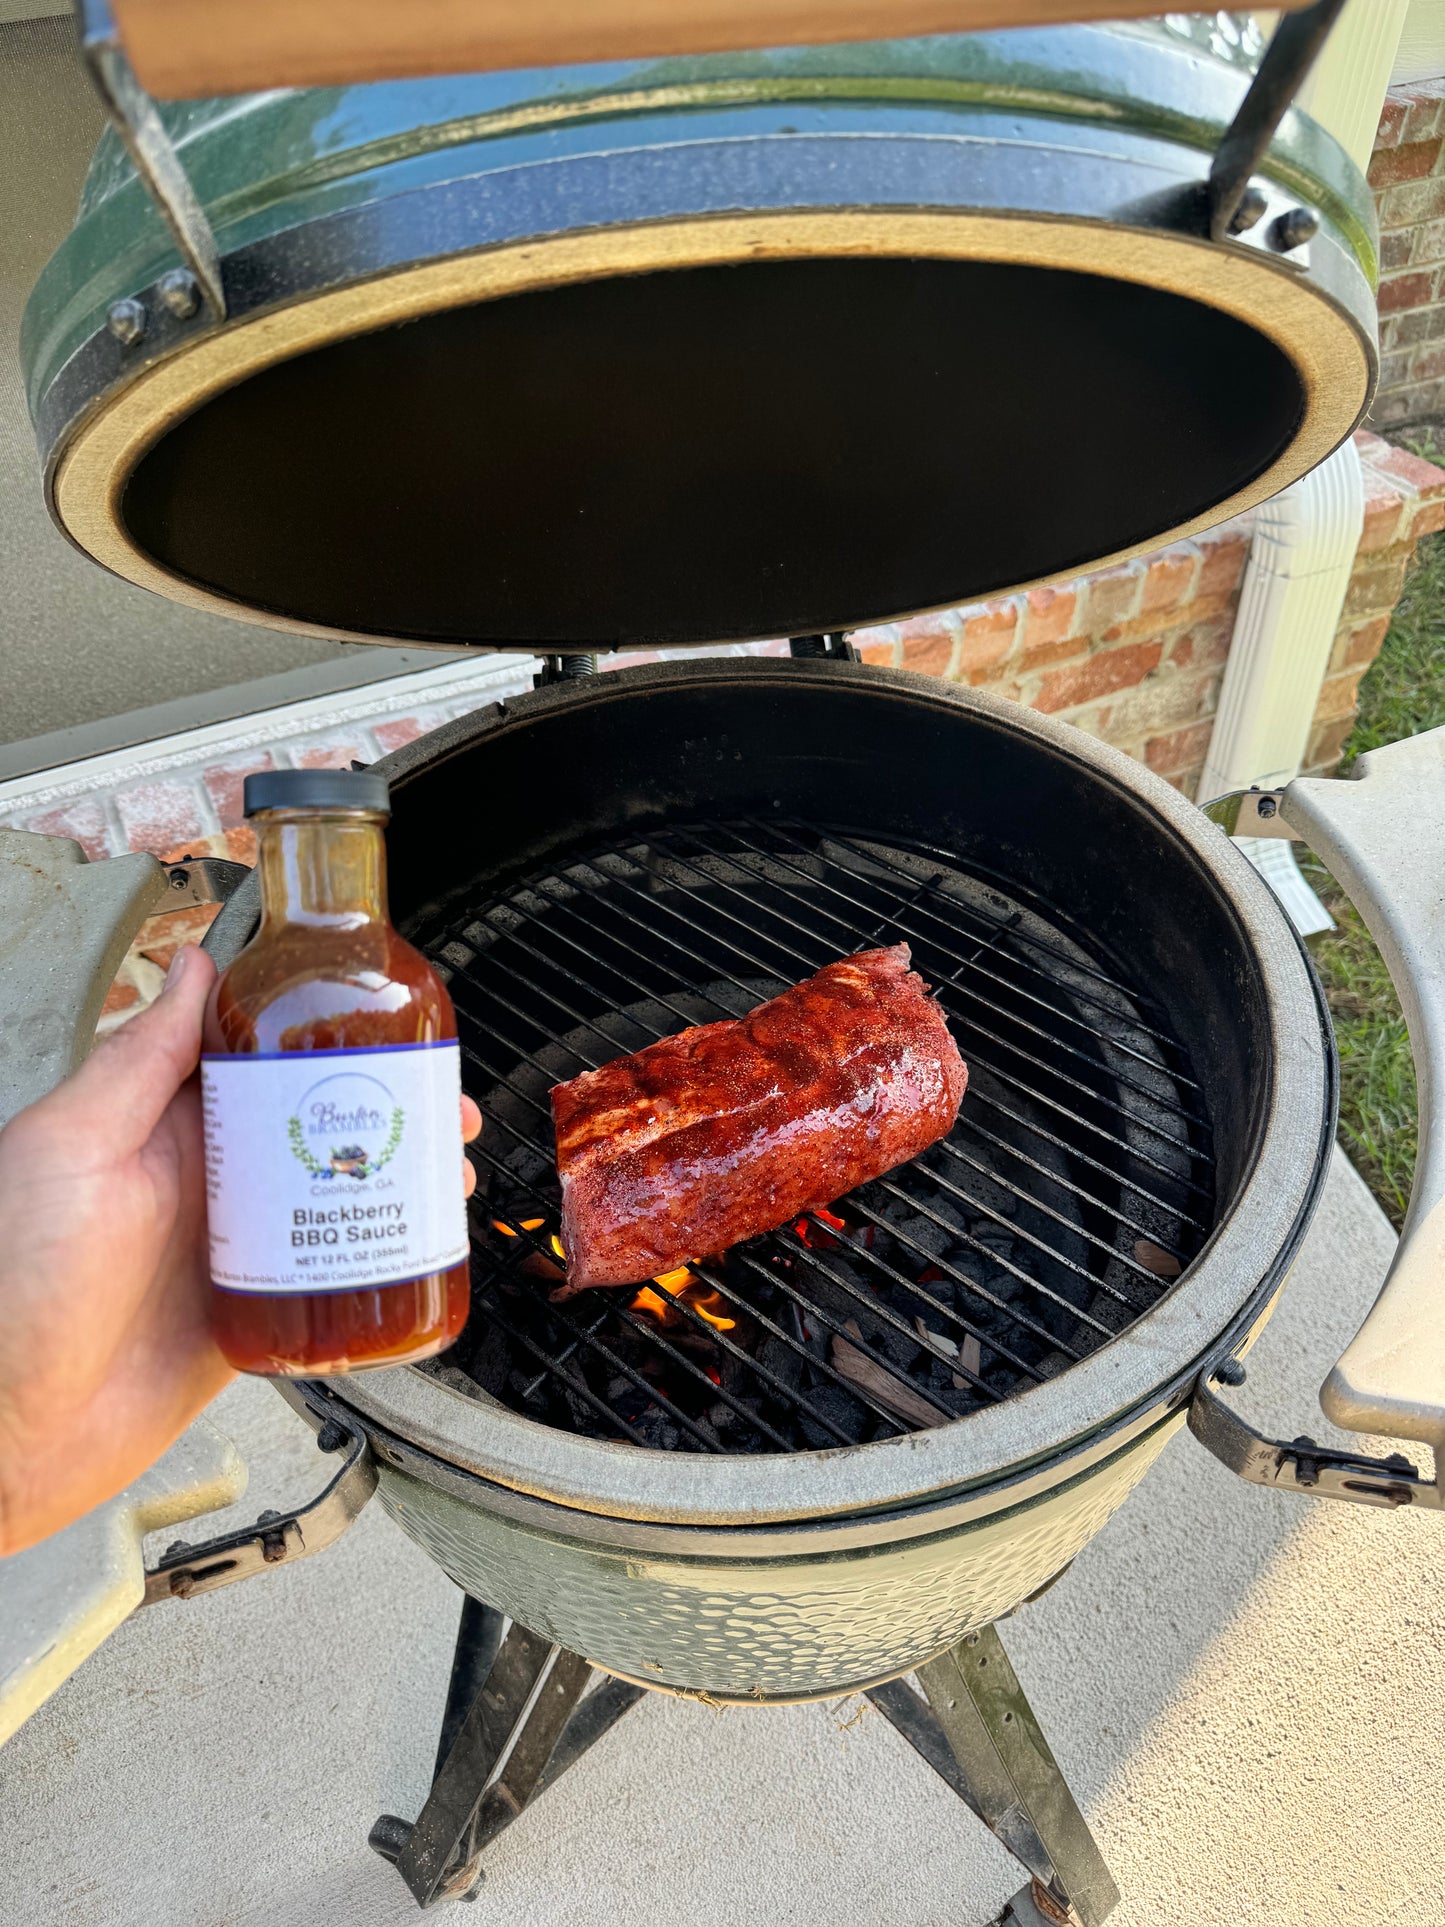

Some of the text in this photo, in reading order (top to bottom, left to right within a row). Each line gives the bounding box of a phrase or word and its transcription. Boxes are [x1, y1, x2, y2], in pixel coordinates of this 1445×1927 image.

[310, 1178, 394, 1197] Coolidge, GA
[293, 1201, 404, 1226] Blackberry
[291, 1222, 407, 1247] BBQ Sauce
[295, 1255, 317, 1266] NET
[321, 1254, 334, 1264] 12
[336, 1253, 350, 1263] FL
[353, 1250, 369, 1261] OZ
